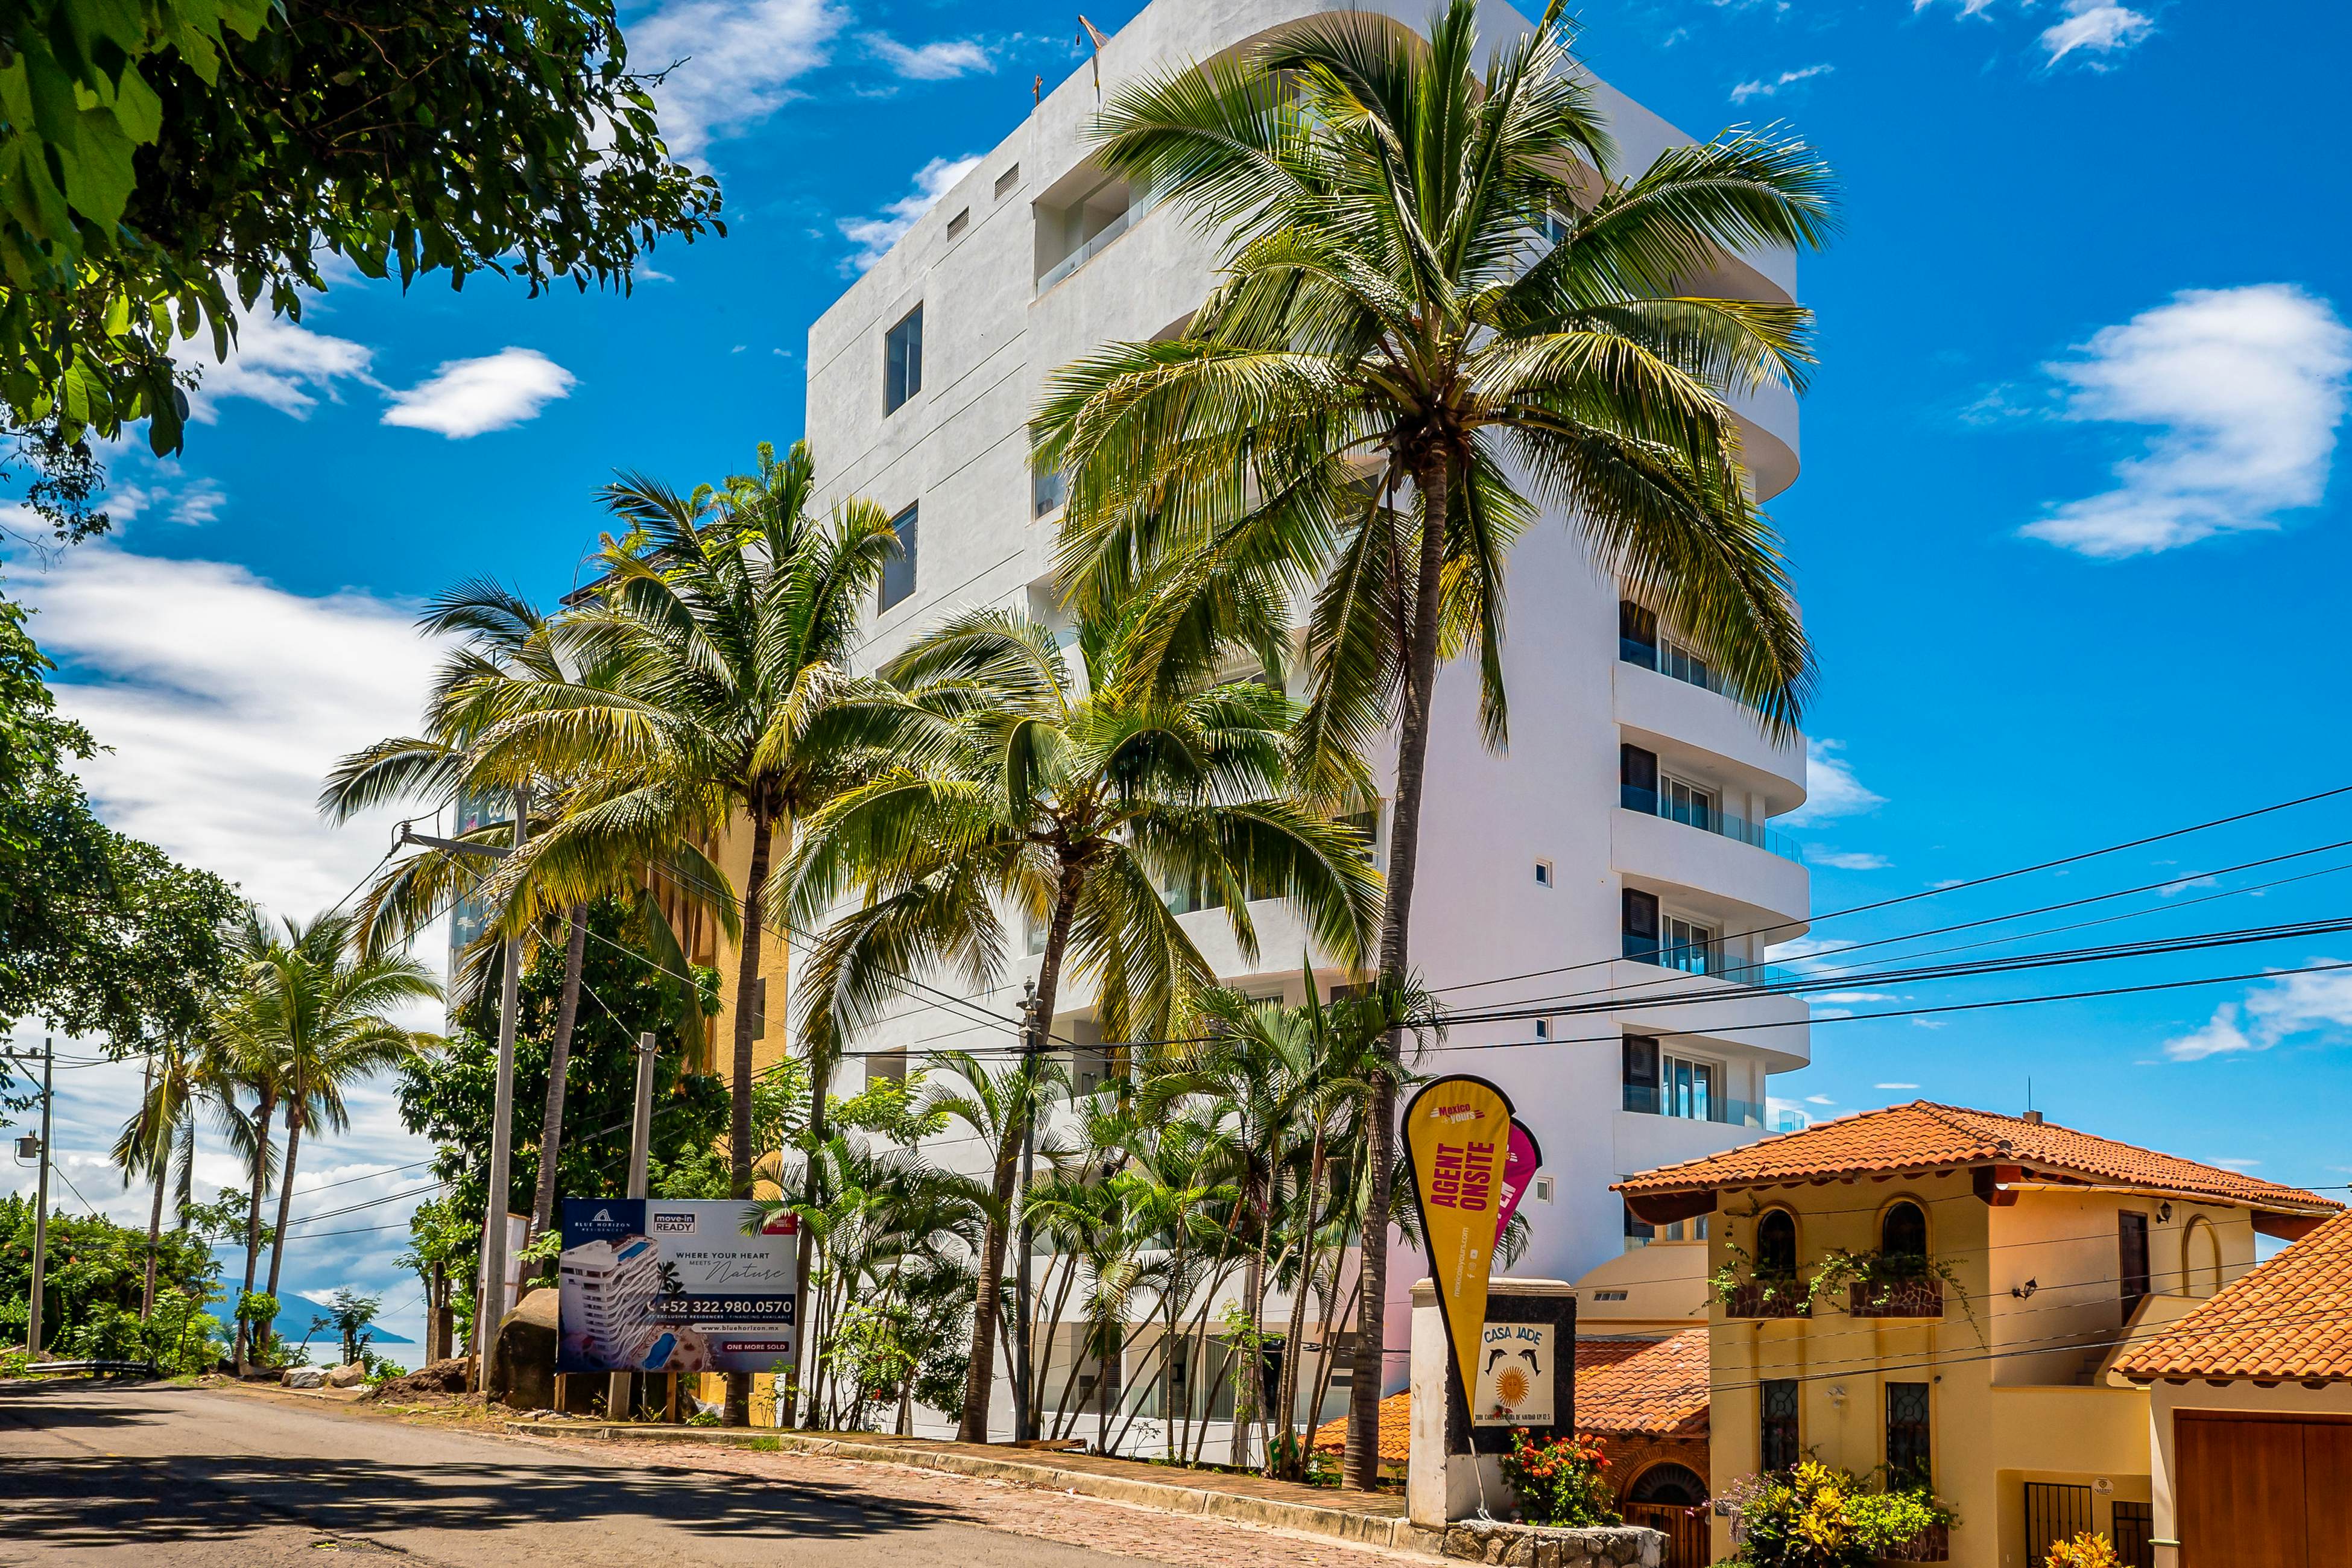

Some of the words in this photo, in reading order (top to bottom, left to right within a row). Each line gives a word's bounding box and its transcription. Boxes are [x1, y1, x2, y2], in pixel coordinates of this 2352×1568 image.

[1438, 1103, 1471, 1117] Mexico
[1450, 1111, 1476, 1125] yours
[1430, 1142, 1464, 1209] AGENT
[1459, 1141, 1495, 1211] ONSITE
[704, 1260, 786, 1283] Nature
[1454, 1227, 1469, 1298] mexicoisyours.com
[660, 1301, 688, 1312] +52
[692, 1301, 792, 1313] 322.980.0570
[1484, 1326, 1513, 1343] CASA
[1516, 1326, 1543, 1346] JADE
